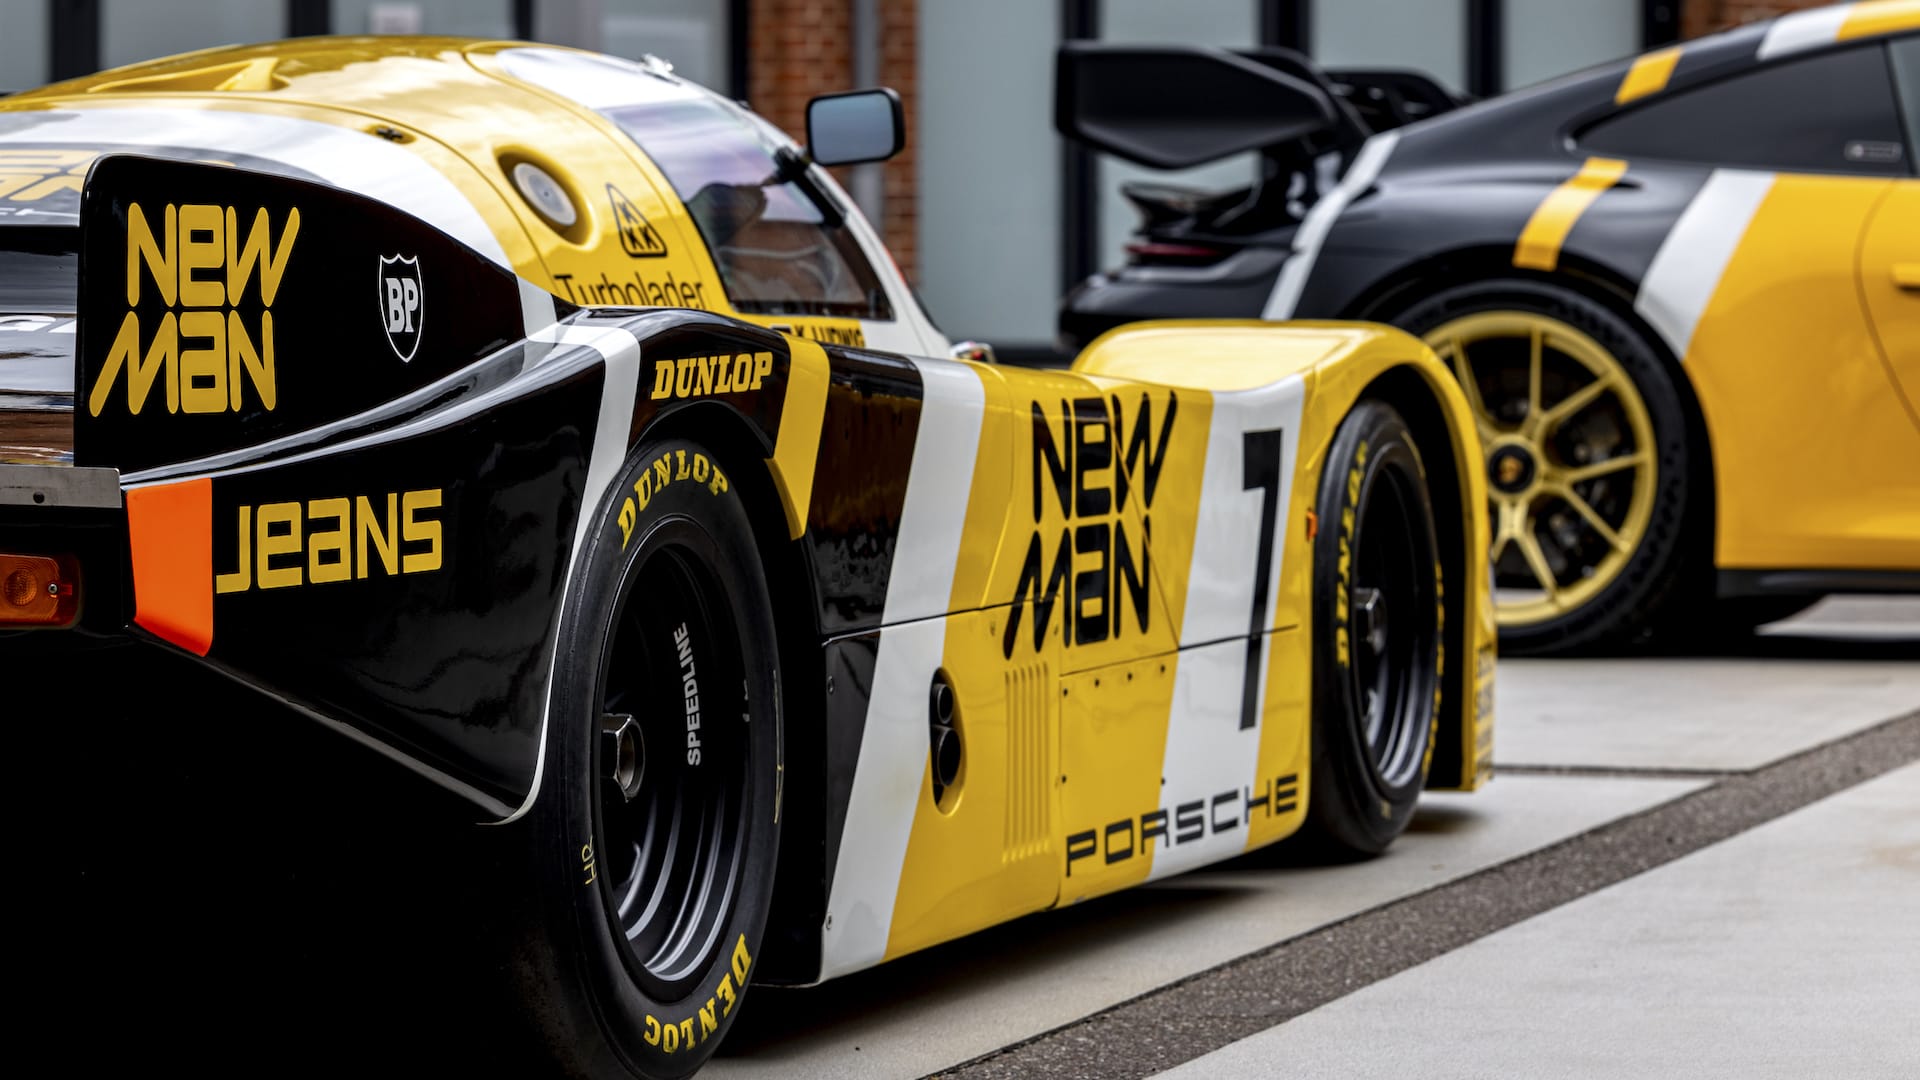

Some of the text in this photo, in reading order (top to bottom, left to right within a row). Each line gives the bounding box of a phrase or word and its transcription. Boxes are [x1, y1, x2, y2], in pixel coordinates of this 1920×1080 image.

[385, 278, 419, 333] BP
[553, 270, 705, 310] Turbolader
[650, 351, 773, 400] DUNLOP
[617, 449, 729, 551] DUNLOP
[1238, 427, 1284, 732] 1
[673, 621, 702, 767] SPEEDLINE
[1065, 773, 1299, 877] PORSCHE
[643, 933, 752, 1055] DENLOC
